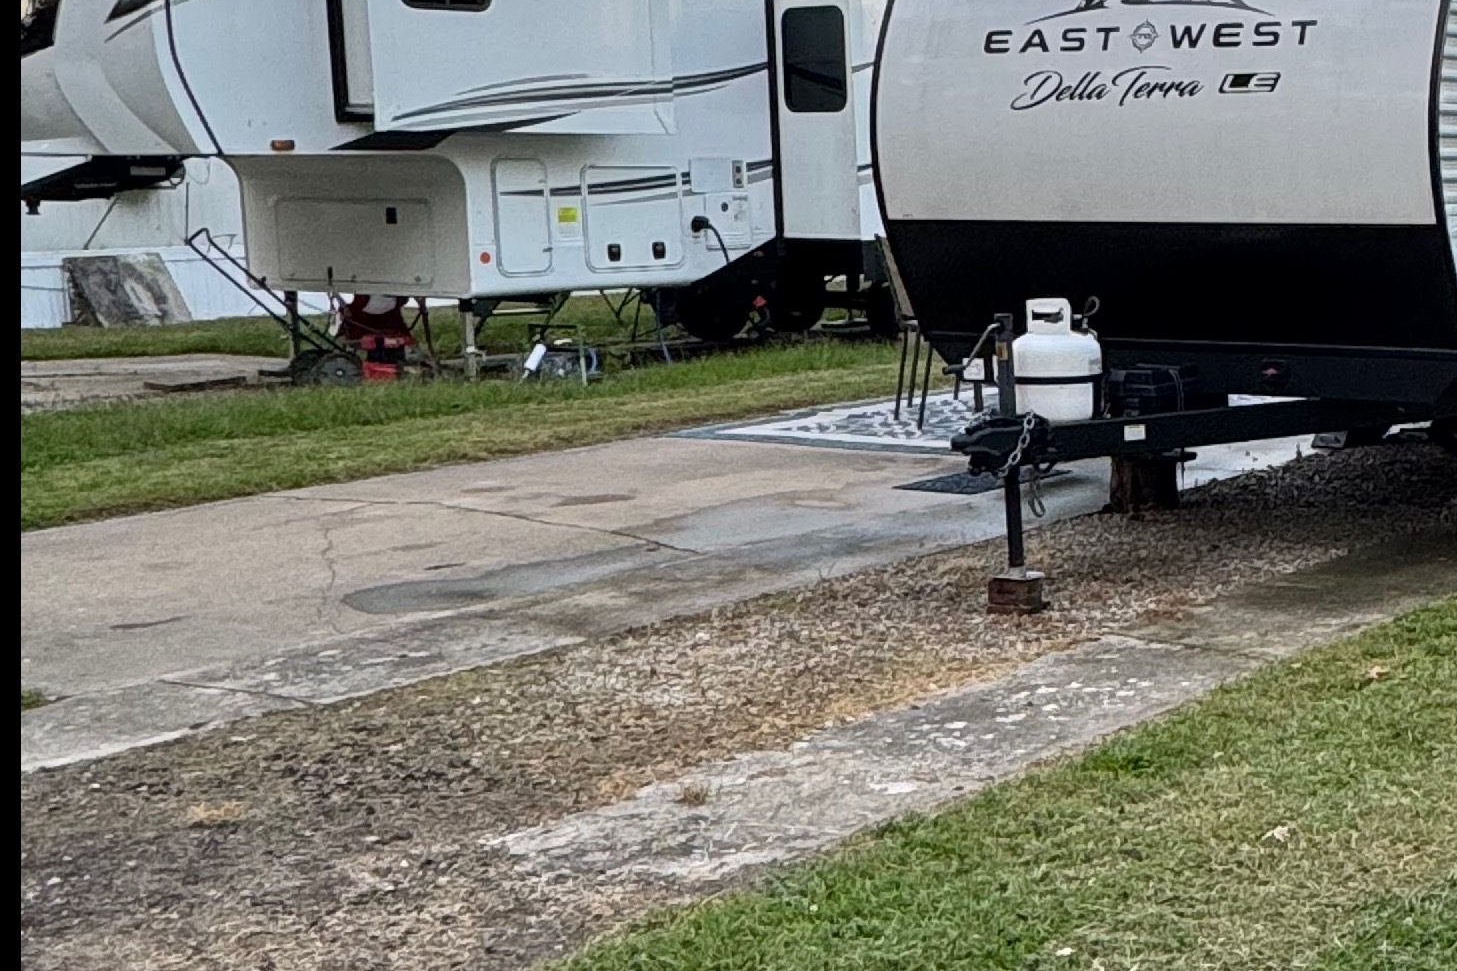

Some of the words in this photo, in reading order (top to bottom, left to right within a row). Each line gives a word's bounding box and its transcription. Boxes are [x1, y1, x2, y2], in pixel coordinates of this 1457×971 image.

[983, 26, 1121, 54] EAST
[1169, 20, 1318, 49] WEST
[1010, 69, 1111, 111] Della
[1111, 65, 1204, 107] Terra
